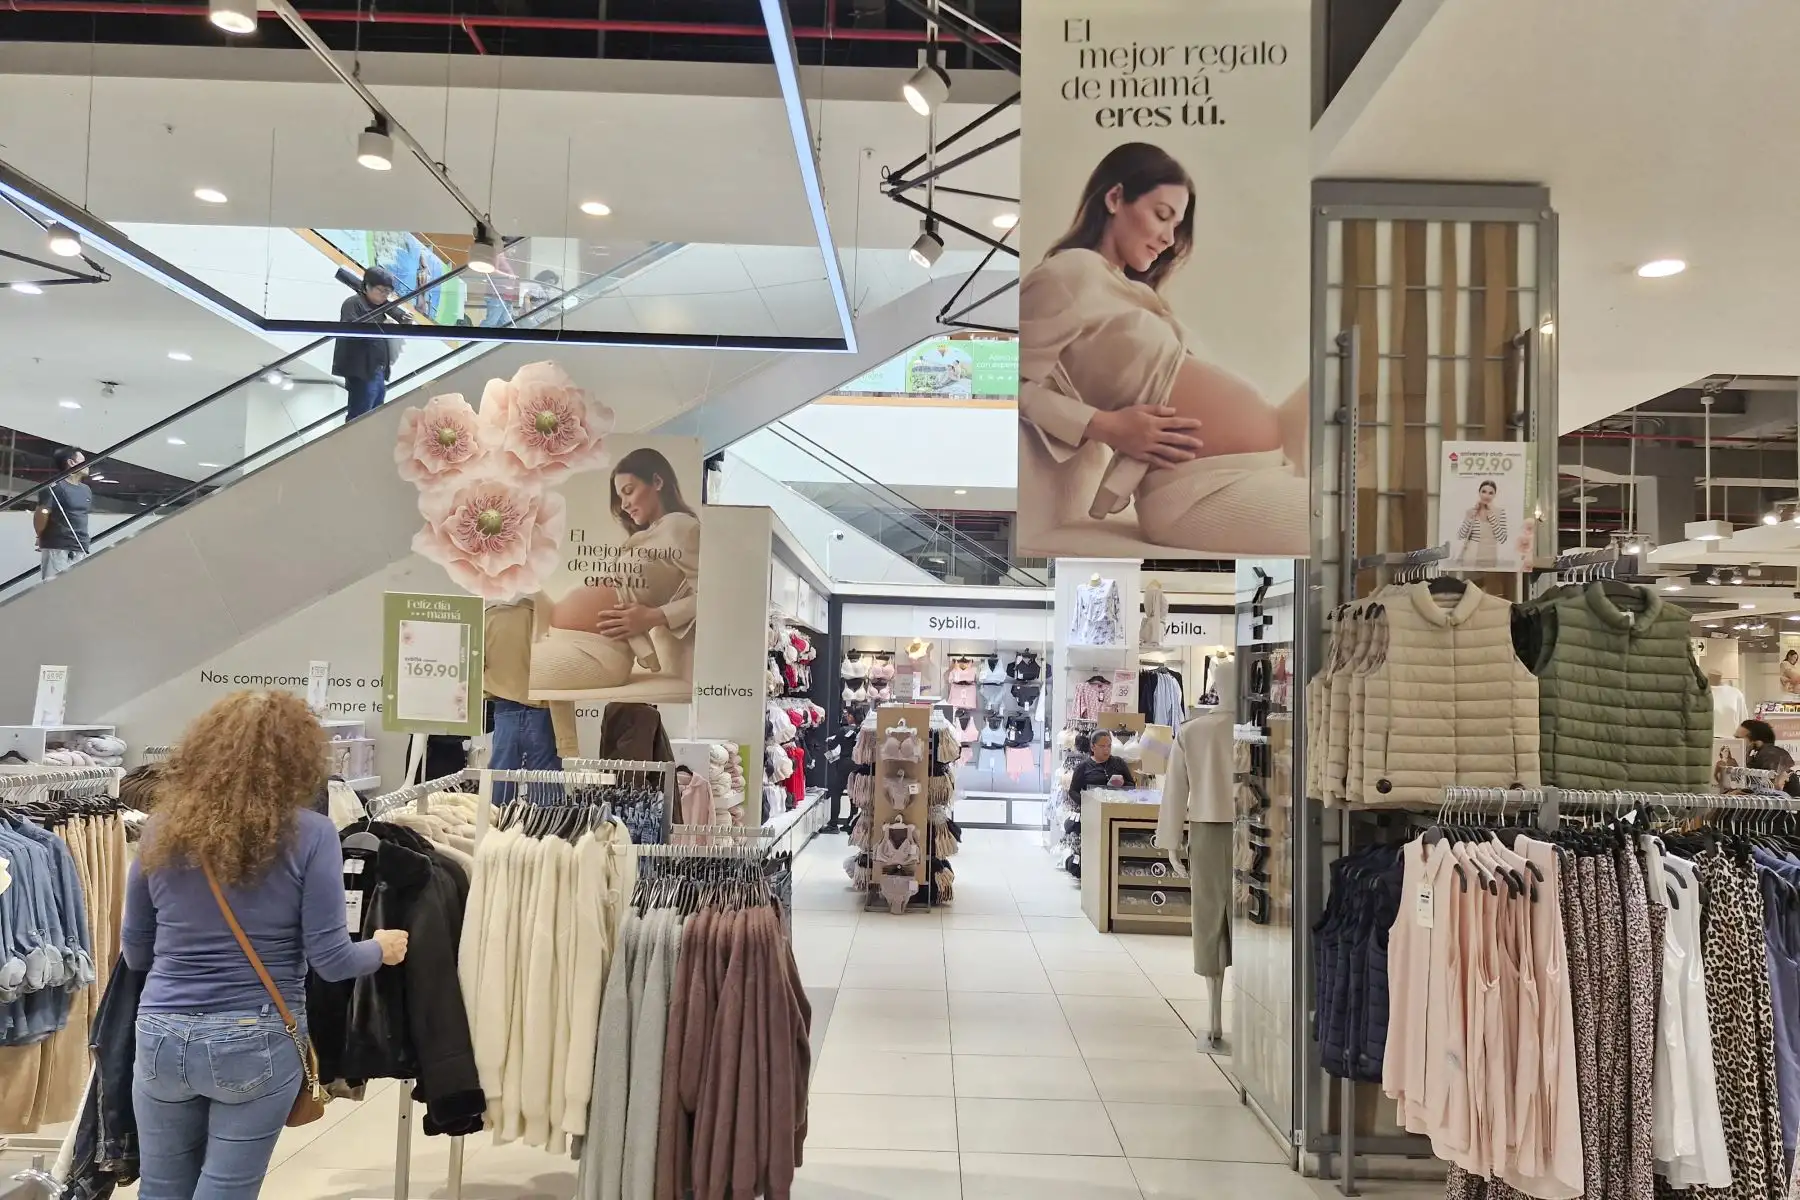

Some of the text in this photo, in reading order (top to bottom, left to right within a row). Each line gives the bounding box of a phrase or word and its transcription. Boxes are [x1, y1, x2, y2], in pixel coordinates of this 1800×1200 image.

[1064, 18, 1091, 43] El
[1079, 41, 1288, 76] mejor regalo
[1061, 67, 1210, 101] de mamá
[1095, 96, 1227, 129] eres tú.
[1464, 457, 1512, 471] 99.90
[570, 529, 585, 542] El
[577, 544, 683, 562] mejor regalo
[567, 556, 643, 574] de mamá
[584, 575, 623, 588] eres
[929, 616, 980, 631] Sybilla.
[1164, 621, 1206, 636] ybilla.
[407, 662, 458, 678] 169.90
[200, 670, 229, 684] Nos
[233, 672, 352, 688] compromemos
[356, 678, 366, 687] a
[696, 684, 753, 697] ectativas
[326, 701, 367, 714] mpre
[575, 708, 599, 717] ara
